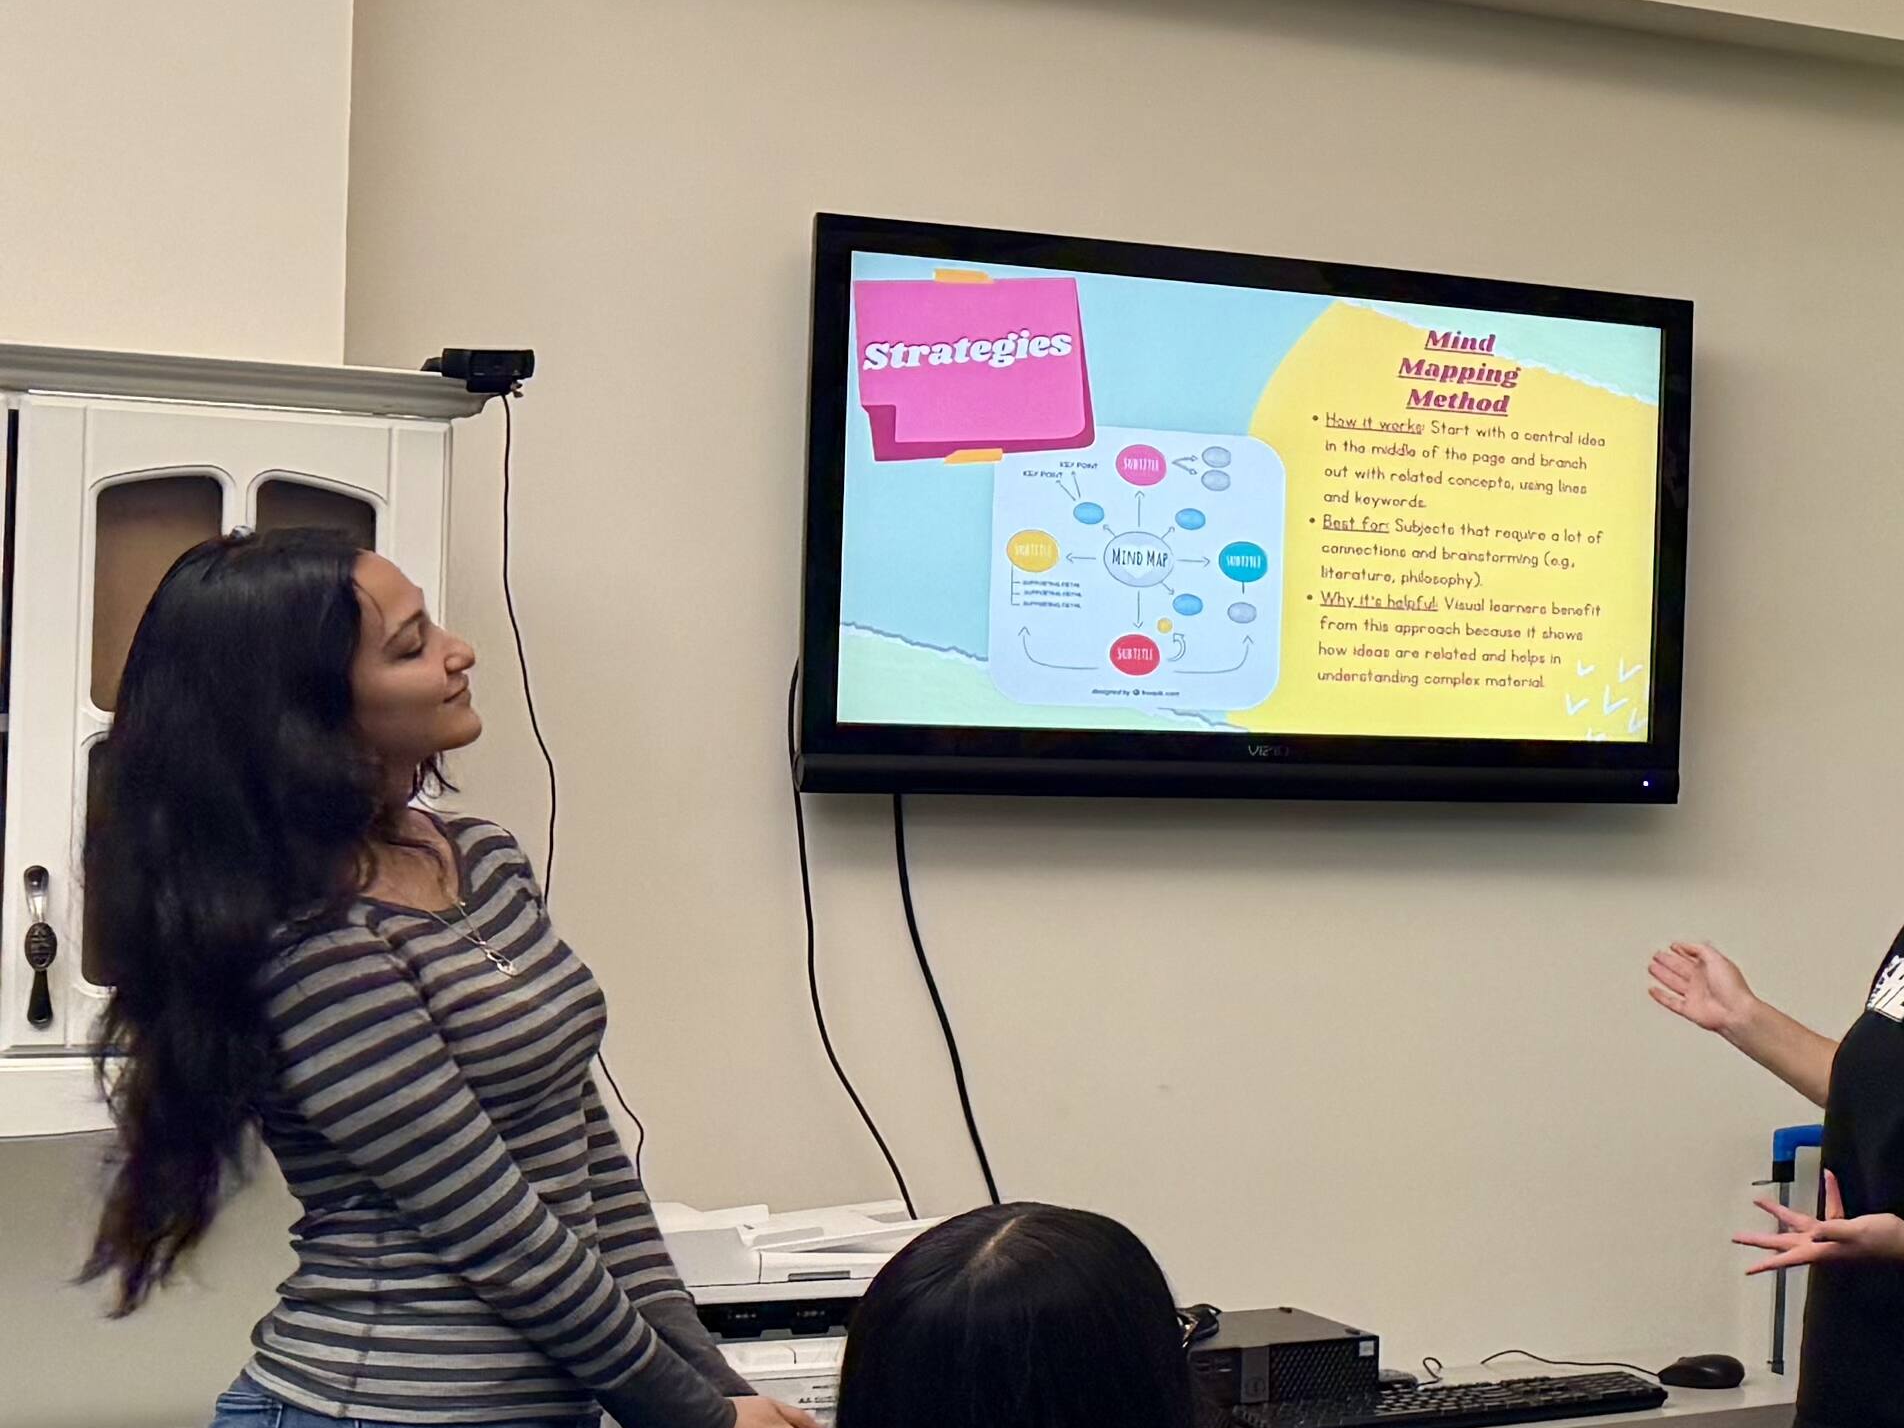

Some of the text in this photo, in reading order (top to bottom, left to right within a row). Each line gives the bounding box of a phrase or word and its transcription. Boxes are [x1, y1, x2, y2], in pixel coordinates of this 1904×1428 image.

[863, 328, 1072, 370] Strategies
[1424, 330, 1496, 355] Mind
[1398, 357, 1521, 388] Mapping
[1406, 389, 1510, 415] Method
[1326, 412, 1357, 428] How
[1363, 417, 1373, 429] it
[1431, 420, 1469, 435] Start
[1476, 426, 1505, 439] with
[1511, 430, 1519, 441] a
[1524, 431, 1573, 444] central
[1578, 433, 1606, 447] idea
[1325, 440, 1587, 470] in the middle of the page and branch
[1324, 466, 1587, 495] out with related concepts, using lines
[1324, 490, 1349, 503] and
[1323, 514, 1355, 530] Best
[1395, 518, 1454, 536] Subjects
[1461, 523, 1490, 537] that
[1495, 528, 1546, 542] require
[1551, 532, 1559, 542] a
[1564, 529, 1581, 543] lot
[1587, 531, 1604, 544] of
[1111, 547, 1169, 567] MIND MAP
[1321, 544, 1406, 557] connections
[1412, 546, 1437, 559] and
[1442, 547, 1538, 568] brainstorming
[1321, 565, 1395, 583] literature,
[1320, 590, 1354, 607] Why
[1360, 594, 1381, 608] it's
[1444, 597, 1485, 612] Visual
[1490, 599, 1547, 614] learners
[1552, 602, 1601, 616] benefit
[1320, 616, 1583, 641] from this approach because it shows
[1318, 641, 1561, 666] how ideas are related and helps in
[1317, 668, 1418, 687] understanding
[1424, 672, 1480, 687] complex
